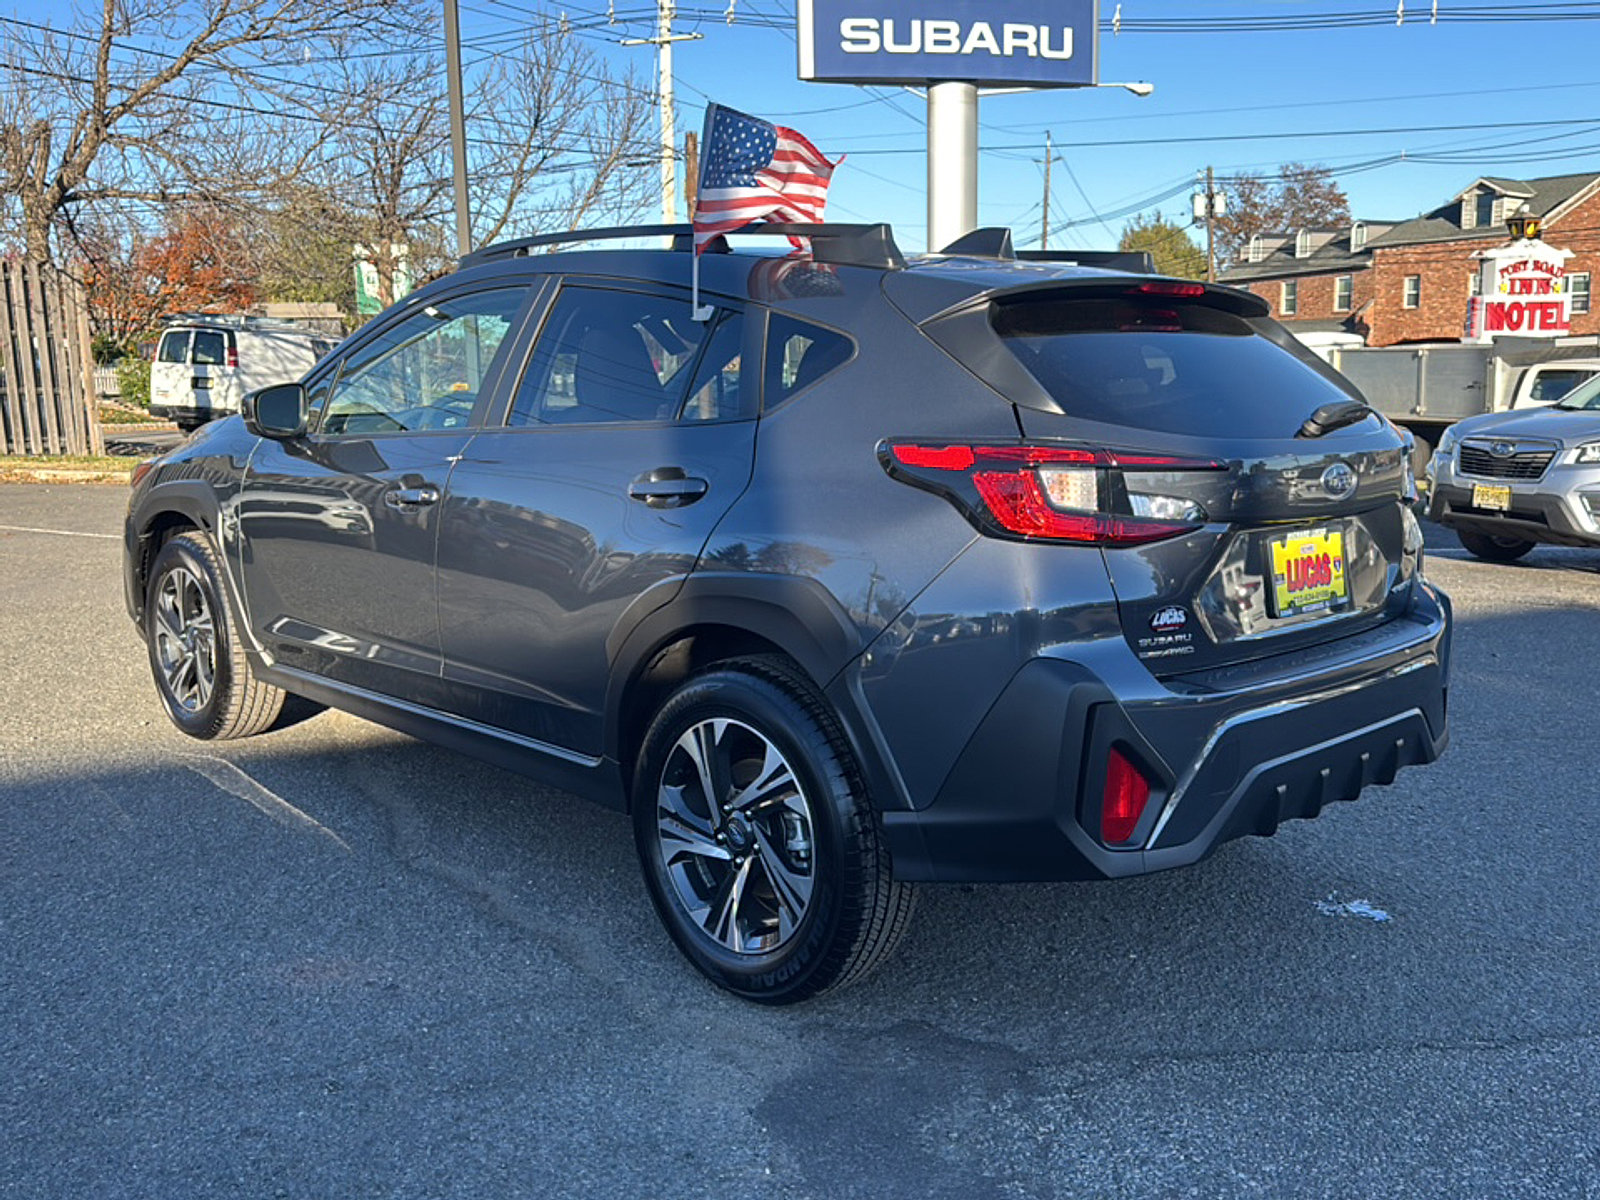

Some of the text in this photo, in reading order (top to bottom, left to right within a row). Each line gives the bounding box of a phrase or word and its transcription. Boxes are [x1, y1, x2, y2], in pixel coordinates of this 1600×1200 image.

[839, 17, 1074, 60] SUBARU
[1507, 277, 1553, 296] INN
[1484, 301, 1572, 332] MOTEL
[1286, 552, 1332, 593] LUCAS
[1152, 608, 1186, 627] LUCAS
[1138, 633, 1192, 648] SUBARU
